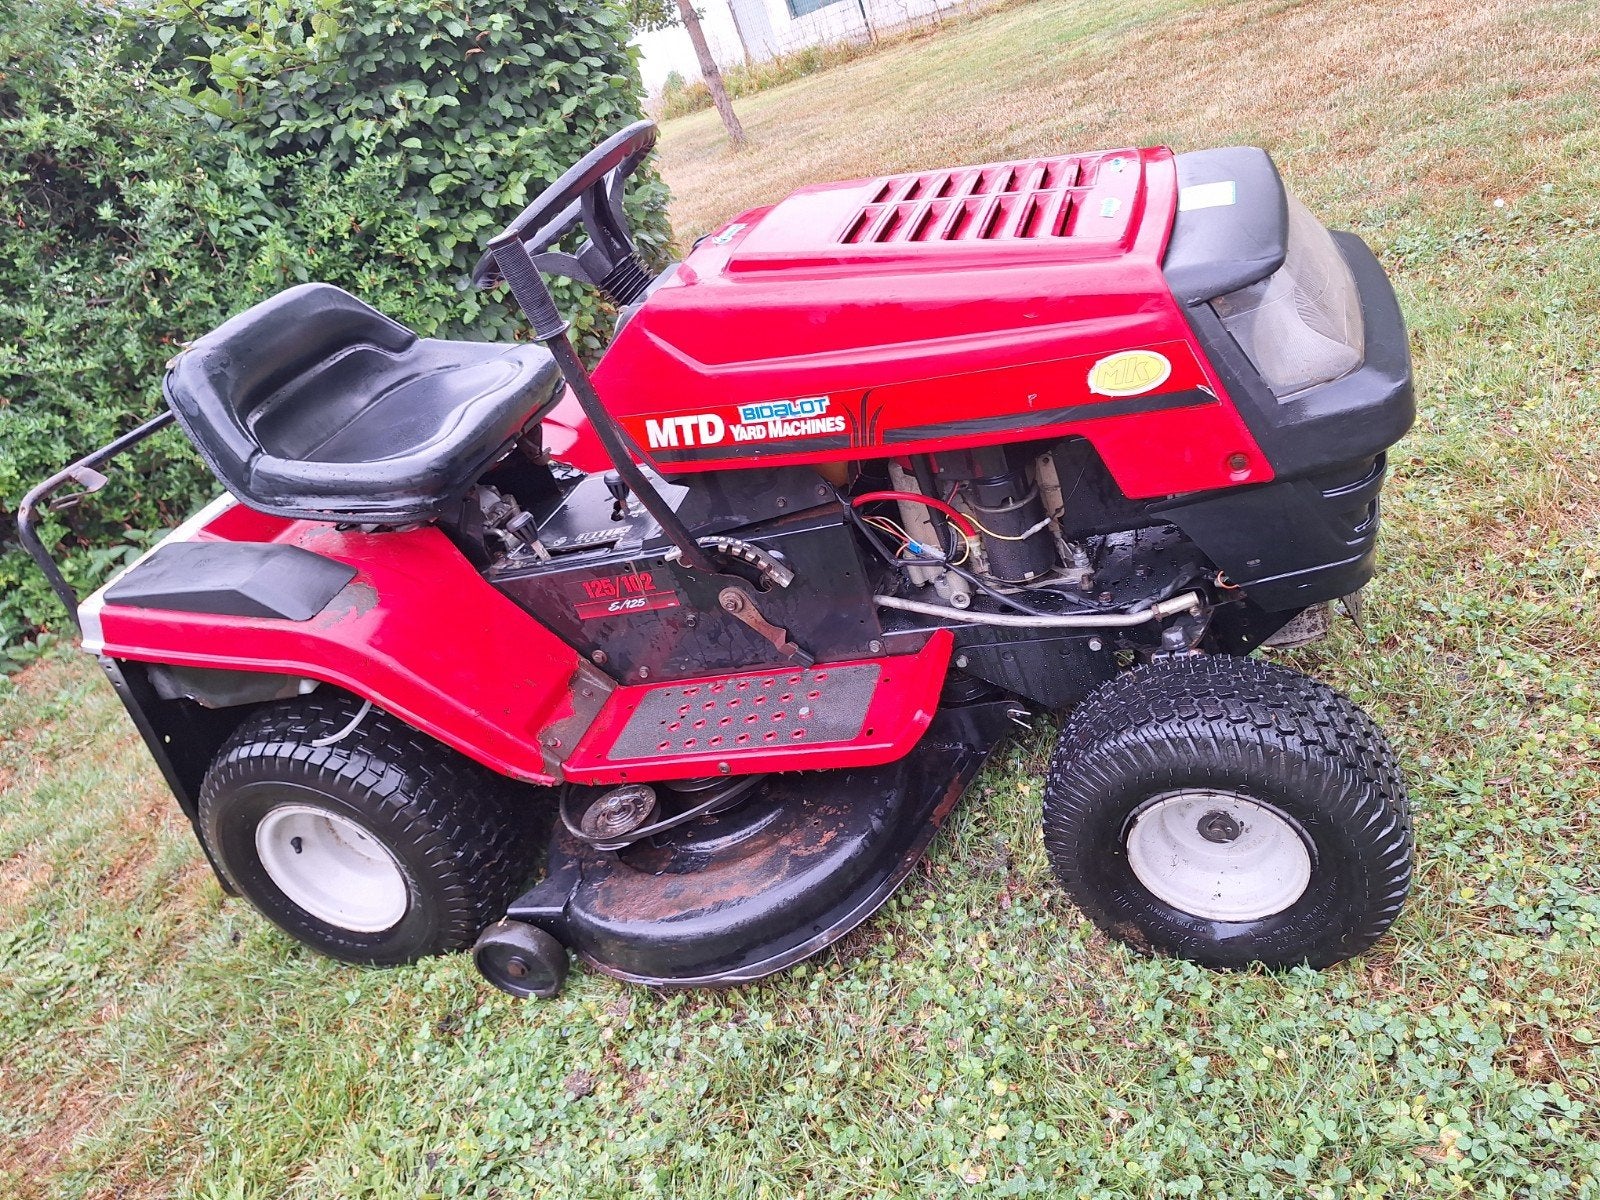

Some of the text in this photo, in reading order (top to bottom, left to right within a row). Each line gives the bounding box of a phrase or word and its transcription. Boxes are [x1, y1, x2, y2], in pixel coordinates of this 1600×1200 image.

[1096, 357, 1149, 388] MK
[645, 413, 725, 448] MTD
[729, 416, 846, 442] YARD MACHINES
[582, 572, 656, 598] 125/102
